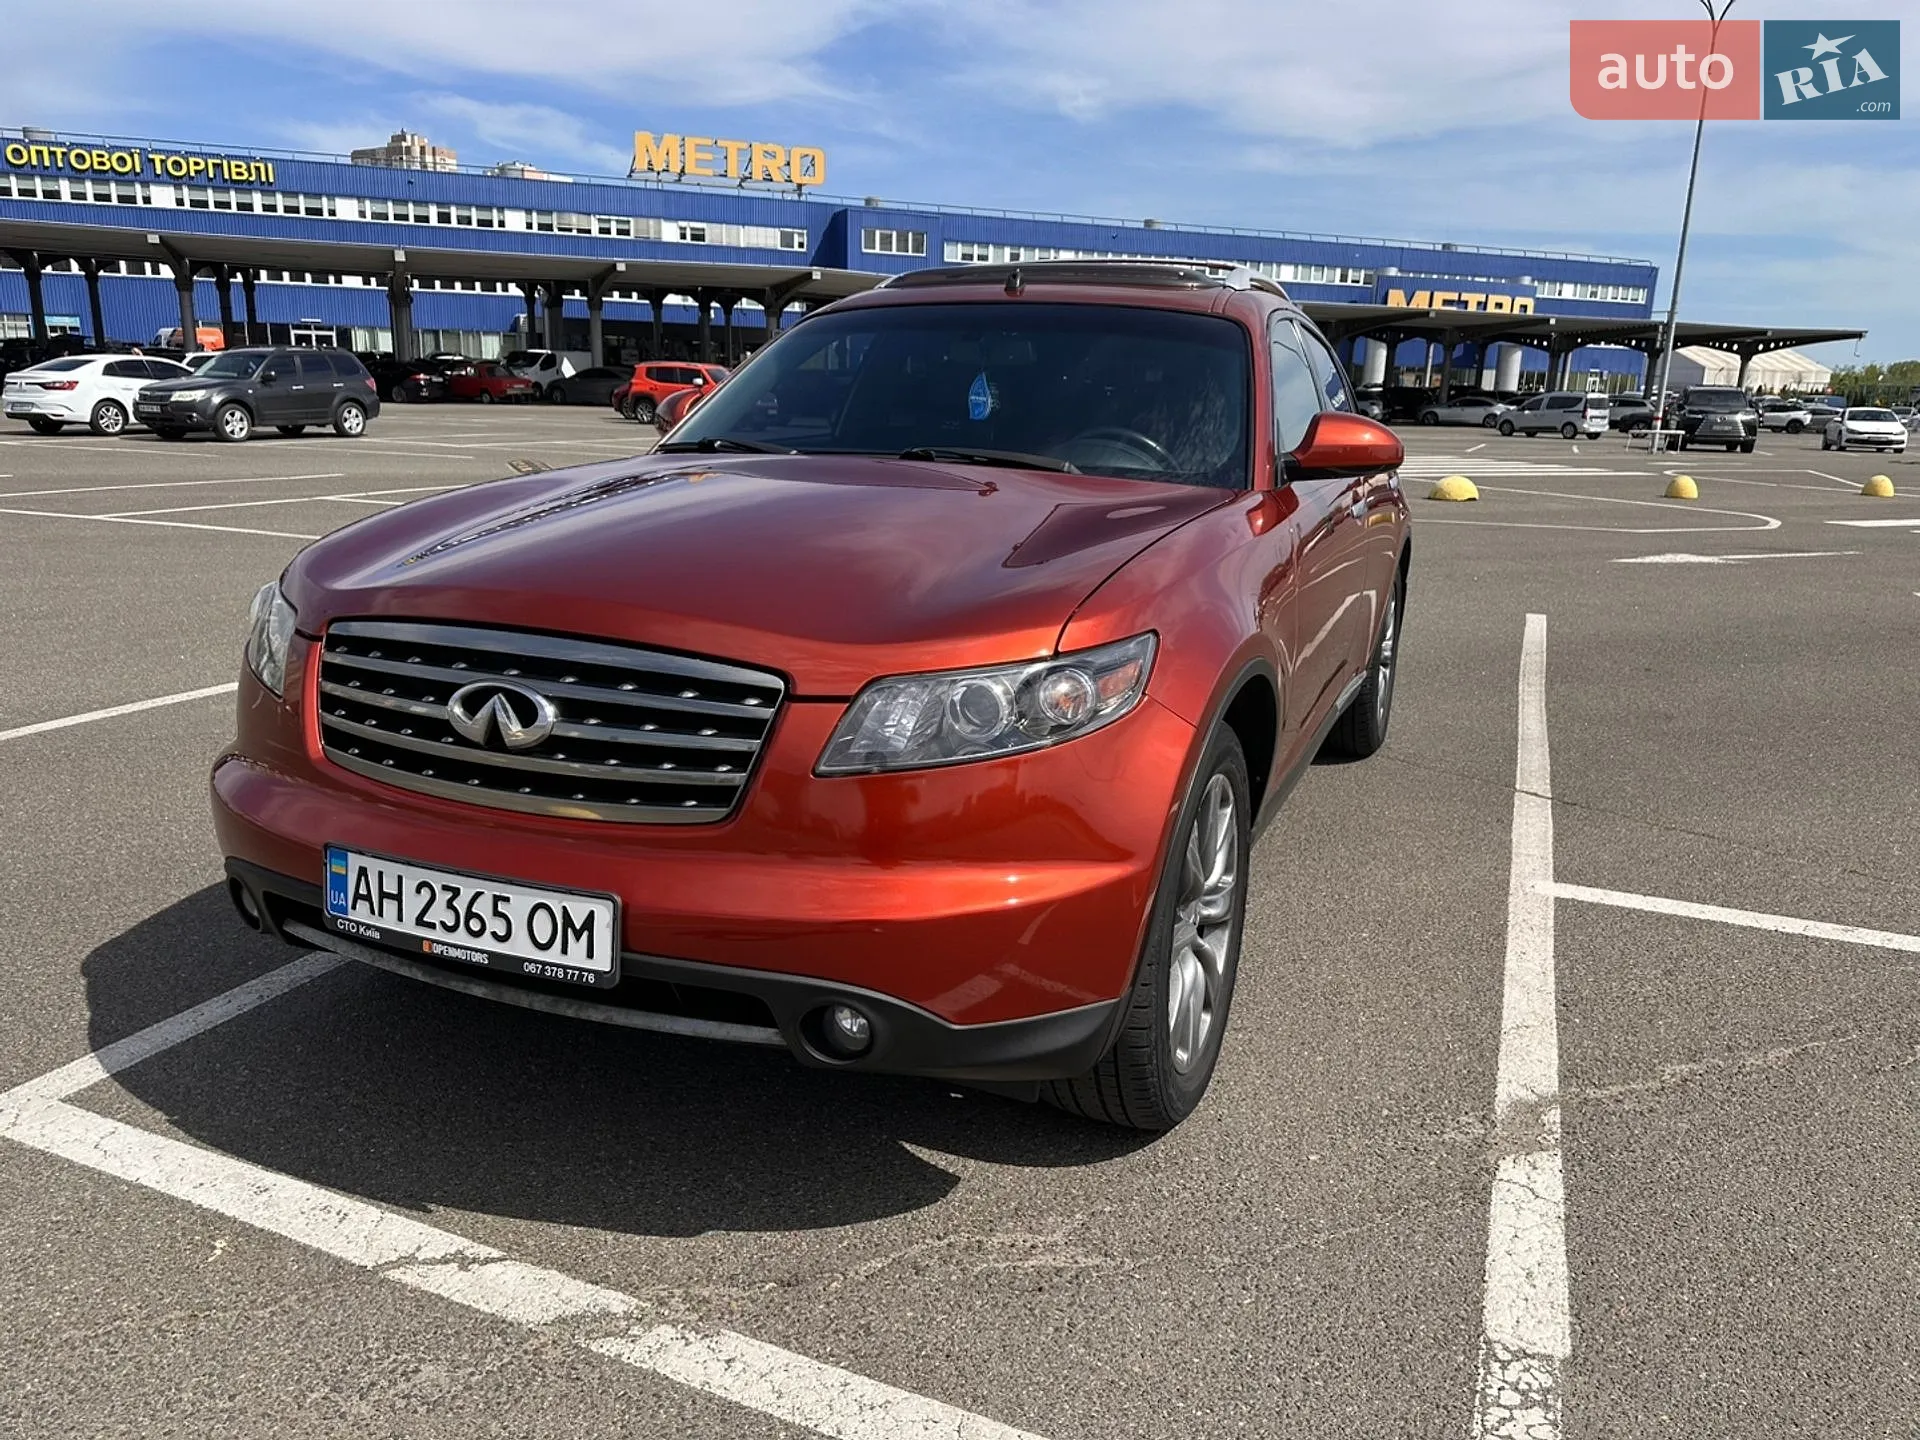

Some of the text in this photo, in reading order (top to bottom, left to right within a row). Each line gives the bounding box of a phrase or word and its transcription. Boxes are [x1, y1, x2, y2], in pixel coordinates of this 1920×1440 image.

[5, 142, 275, 184] ОПТОВОЇ ТОРГІВЛІ
[633, 130, 826, 186] METRO
[330, 889, 347, 906] UA
[350, 865, 596, 960] AH 2365 OM
[336, 918, 380, 939] СТО Київ
[432, 942, 489, 964] OPENMOTORS
[523, 962, 595, 984] 067 378 77 76
